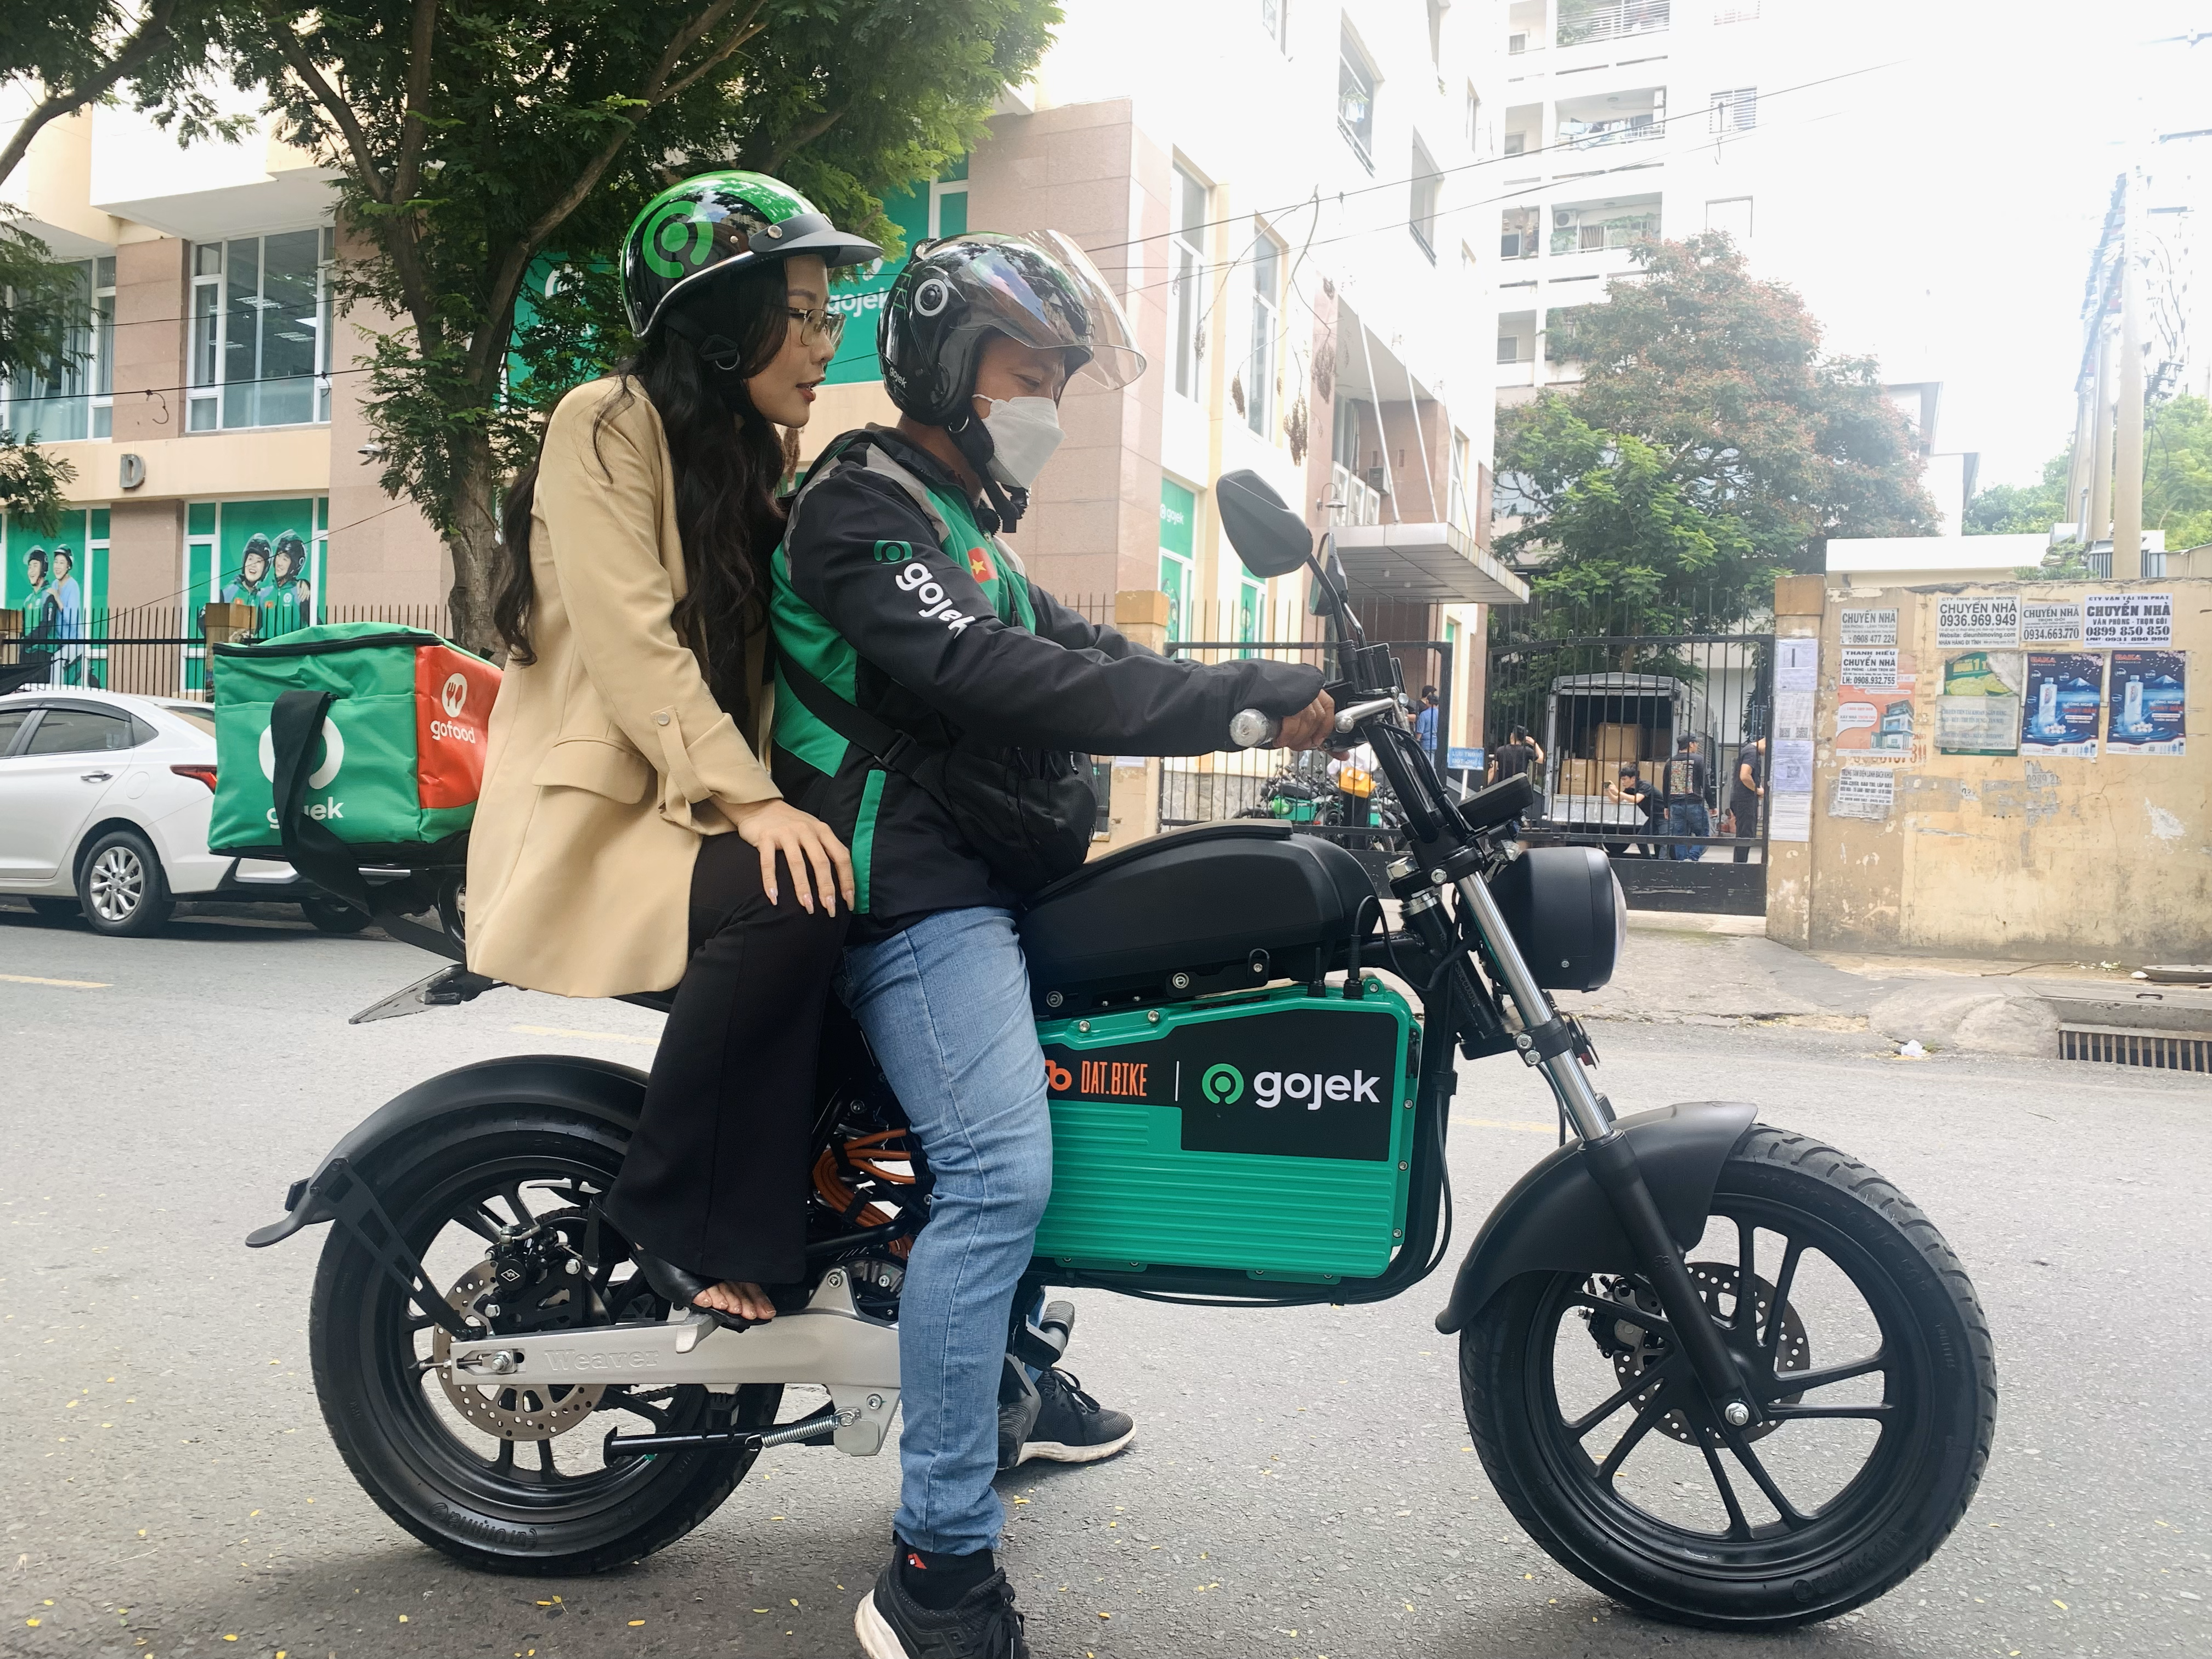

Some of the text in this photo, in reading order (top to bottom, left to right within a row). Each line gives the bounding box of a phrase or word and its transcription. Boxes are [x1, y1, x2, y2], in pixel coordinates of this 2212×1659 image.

[889, 366, 907, 388] gojek
[895, 562, 975, 639] gojek
[1992, 600, 2017, 613] NHÀ
[2024, 606, 2079, 618] CHUYỂN NHÀ
[2087, 601, 2170, 616] CHUYỂN NHÀ
[1842, 609, 1895, 623] CHUYỂN NHÀ
[1940, 614, 2016, 626] 0936.969.949
[2024, 628, 2079, 640] 0934.663.770
[2086, 626, 2170, 636] 0899 850 850
[1853, 635, 1868, 643] 0908
[1870, 635, 1882, 643] 477
[1883, 635, 1894, 643] 224
[1843, 656, 1895, 666] CHUYỂN NHÀ
[430, 720, 476, 744] gofood
[267, 797, 344, 829] gek
[1081, 1060, 1148, 1097] DAT.BIKE
[1253, 1070, 1380, 1110] gojek
[545, 1348, 658, 1371] Weaver
